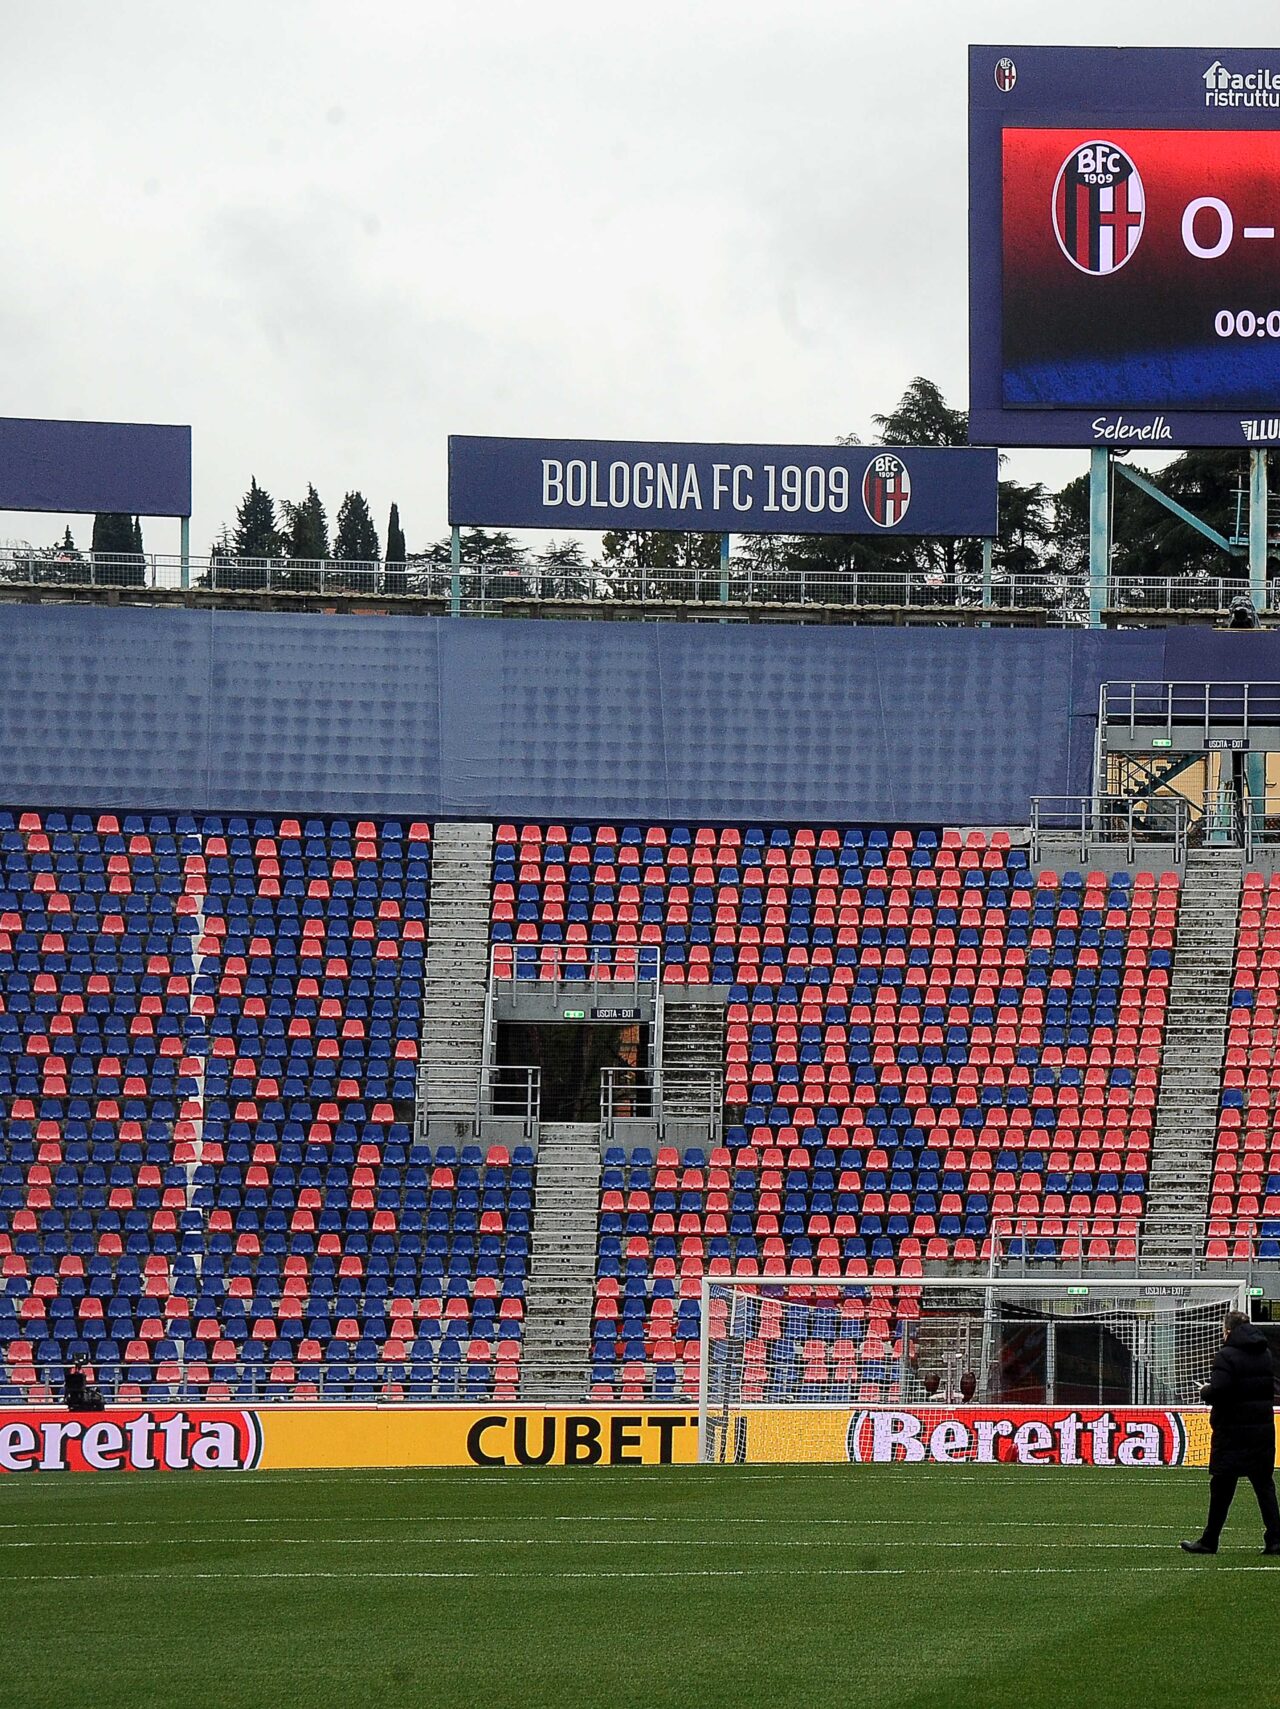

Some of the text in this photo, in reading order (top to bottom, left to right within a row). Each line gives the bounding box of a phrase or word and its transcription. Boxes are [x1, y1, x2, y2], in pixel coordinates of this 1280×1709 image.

[1077, 145, 1121, 173] BFC
[1083, 173, 1114, 184] 1909
[1091, 416, 1173, 440] Selenella
[874, 456, 899, 472] BFC
[541, 459, 849, 513] BOLOGNA FC 1909
[870, 1410, 1165, 1467] Beretta
